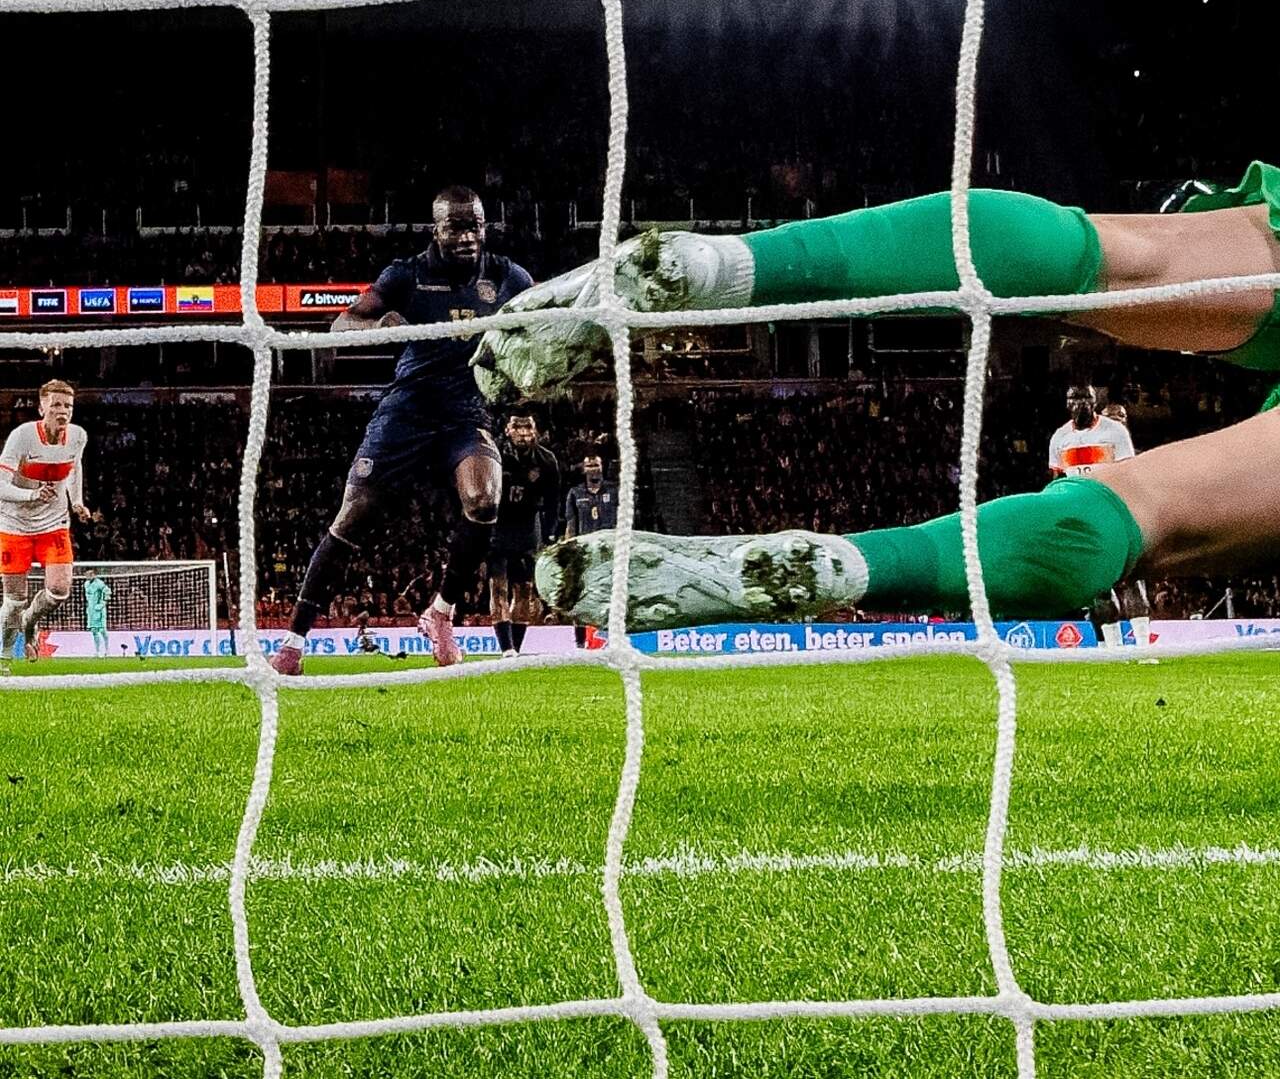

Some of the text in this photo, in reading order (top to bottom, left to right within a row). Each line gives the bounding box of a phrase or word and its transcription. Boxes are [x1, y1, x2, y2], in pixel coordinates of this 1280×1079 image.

[84, 295, 112, 307] UEFA
[134, 635, 194, 656] Voor
[657, 629, 727, 652] Beter
[804, 626, 874, 650] beter
